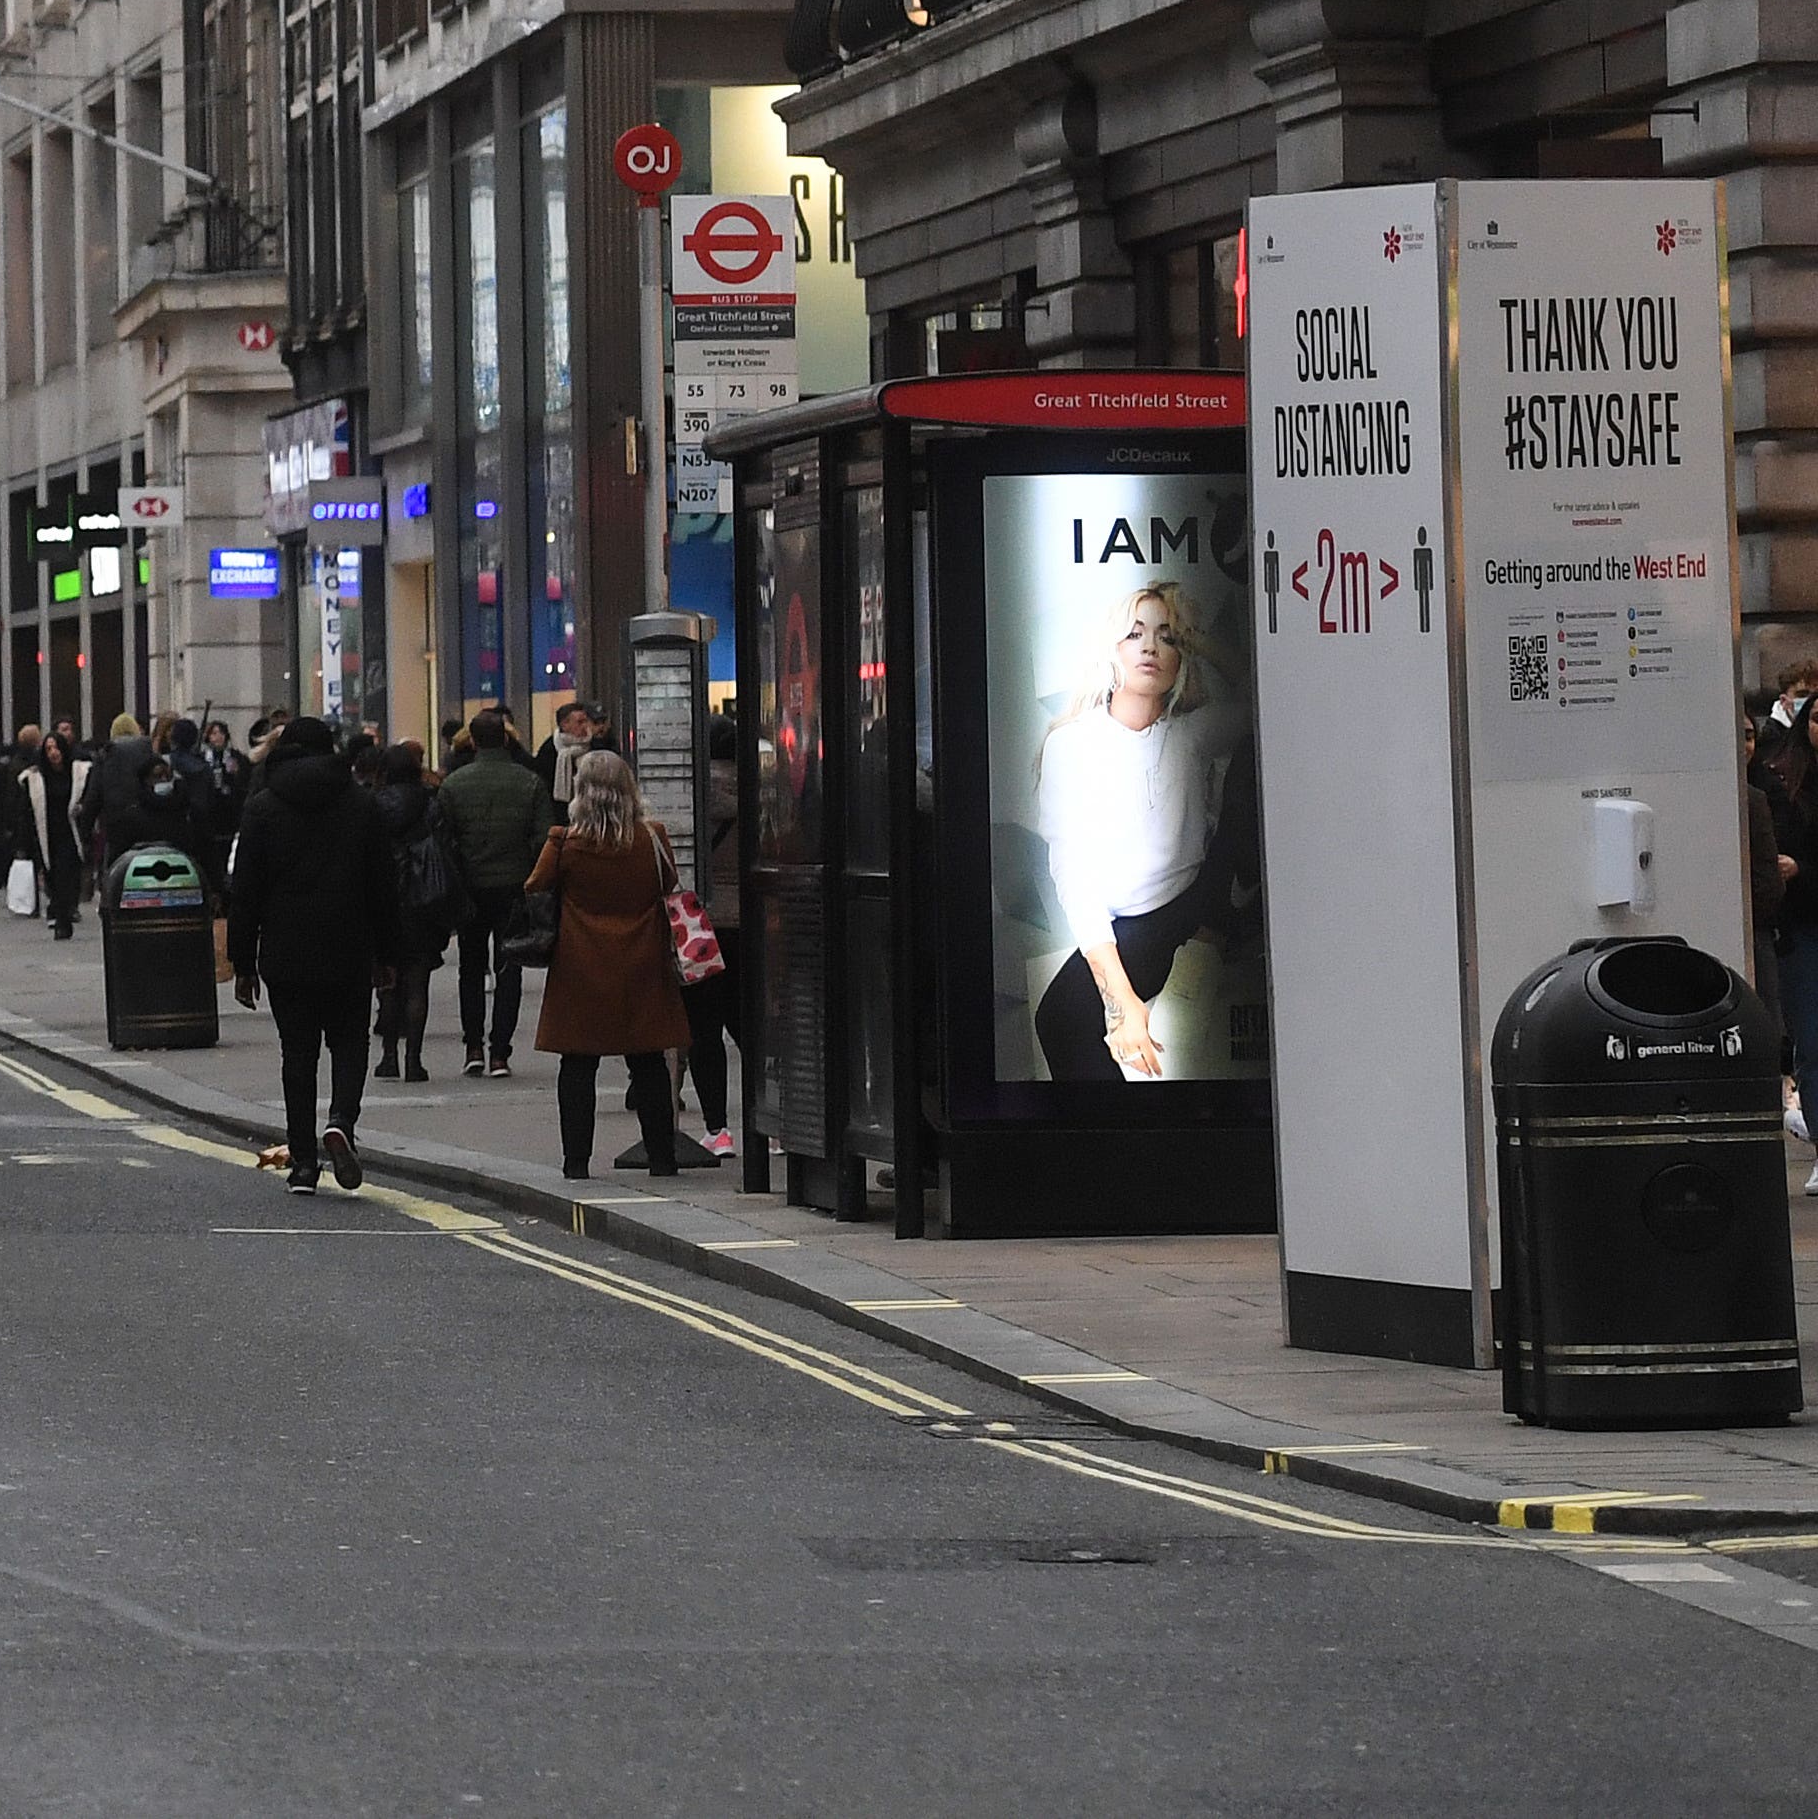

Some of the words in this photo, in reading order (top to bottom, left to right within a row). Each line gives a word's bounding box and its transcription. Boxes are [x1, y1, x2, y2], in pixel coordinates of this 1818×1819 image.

[626, 145, 670, 174] OJ
[711, 295, 731, 304] BUS
[734, 294, 759, 303] STOP
[677, 311, 706, 323] Great
[709, 310, 758, 322] Titchfield
[760, 310, 791, 322] Street
[1499, 298, 1610, 373] THANK
[1617, 296, 1679, 371] YOU
[1295, 305, 1378, 382] SOCIAL
[687, 384, 705, 398] 55
[729, 384, 746, 399] 73
[770, 384, 787, 397] 98
[1034, 393, 1082, 409] Great
[1088, 392, 1170, 409] Titchfield
[1175, 393, 1228, 409] Street
[683, 419, 710, 433] 390
[1504, 392, 1682, 471] #STAYSAFE
[1273, 399, 1412, 478] DISTANCING
[1106, 447, 1192, 463] JCDecaux
[679, 489, 717, 502] N207
[313, 501, 381, 520] OFFICE
[1073, 517, 1084, 564] I
[1099, 517, 1199, 564] AM
[210, 568, 278, 584] EXCHANGE
[1485, 558, 1543, 590] Getting
[1546, 556, 1603, 582] around
[1606, 556, 1632, 581] the
[1633, 554, 1674, 580] West
[1676, 552, 1707, 579] End
[1318, 528, 1372, 634] 2m
[324, 552, 341, 656] MONEY
[1581, 789, 1598, 798] HAND
[1637, 1042, 1687, 1059] general
[1687, 1041, 1716, 1054] litter
